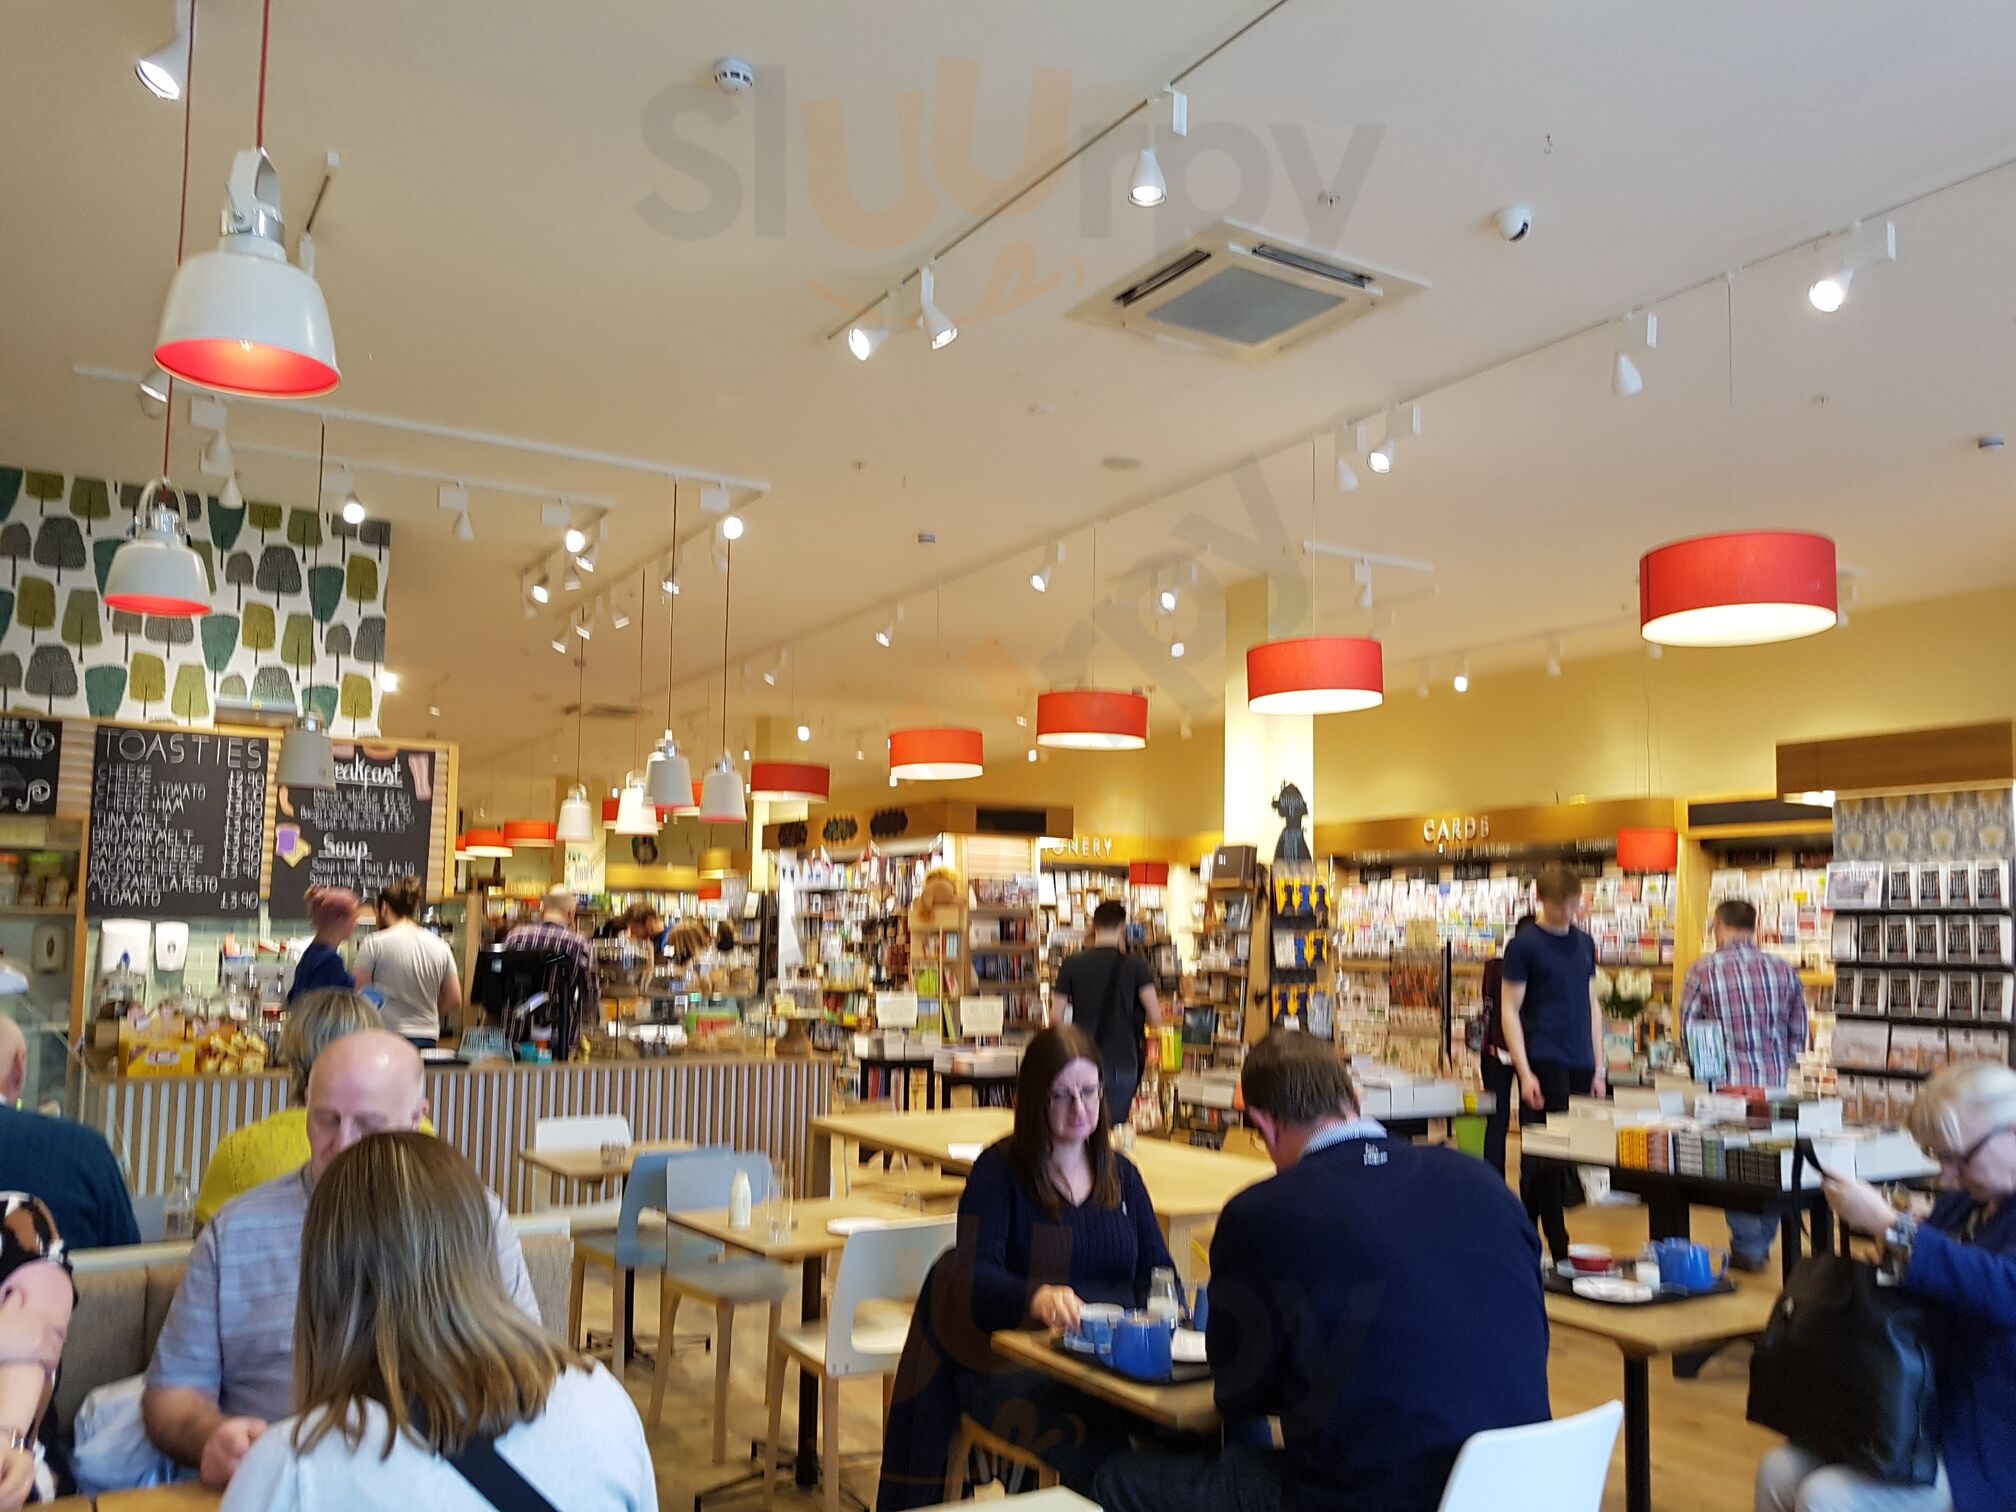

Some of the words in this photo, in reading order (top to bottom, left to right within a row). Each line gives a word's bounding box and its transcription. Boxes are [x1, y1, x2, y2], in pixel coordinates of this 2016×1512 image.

[99, 728, 262, 769] TOASTIES
[97, 762, 151, 783] CHEESE
[335, 752, 402, 789] eakfast
[96, 780, 150, 798] CHEESE
[159, 781, 206, 801] TOMATO
[95, 795, 149, 812] CHEESE
[157, 796, 184, 814] HAM
[93, 811, 127, 829] TUNA
[131, 813, 171, 830] MELT
[1423, 815, 1490, 842] CARDS
[122, 827, 153, 845] PORK
[155, 829, 194, 847] MELT
[92, 843, 150, 861] SAUSAGE
[156, 845, 204, 863] CHEESE
[323, 832, 368, 865] Soup
[90, 856, 135, 875] BACON
[142, 860, 195, 877] CHEESE
[100, 889, 161, 908] TOMATO
